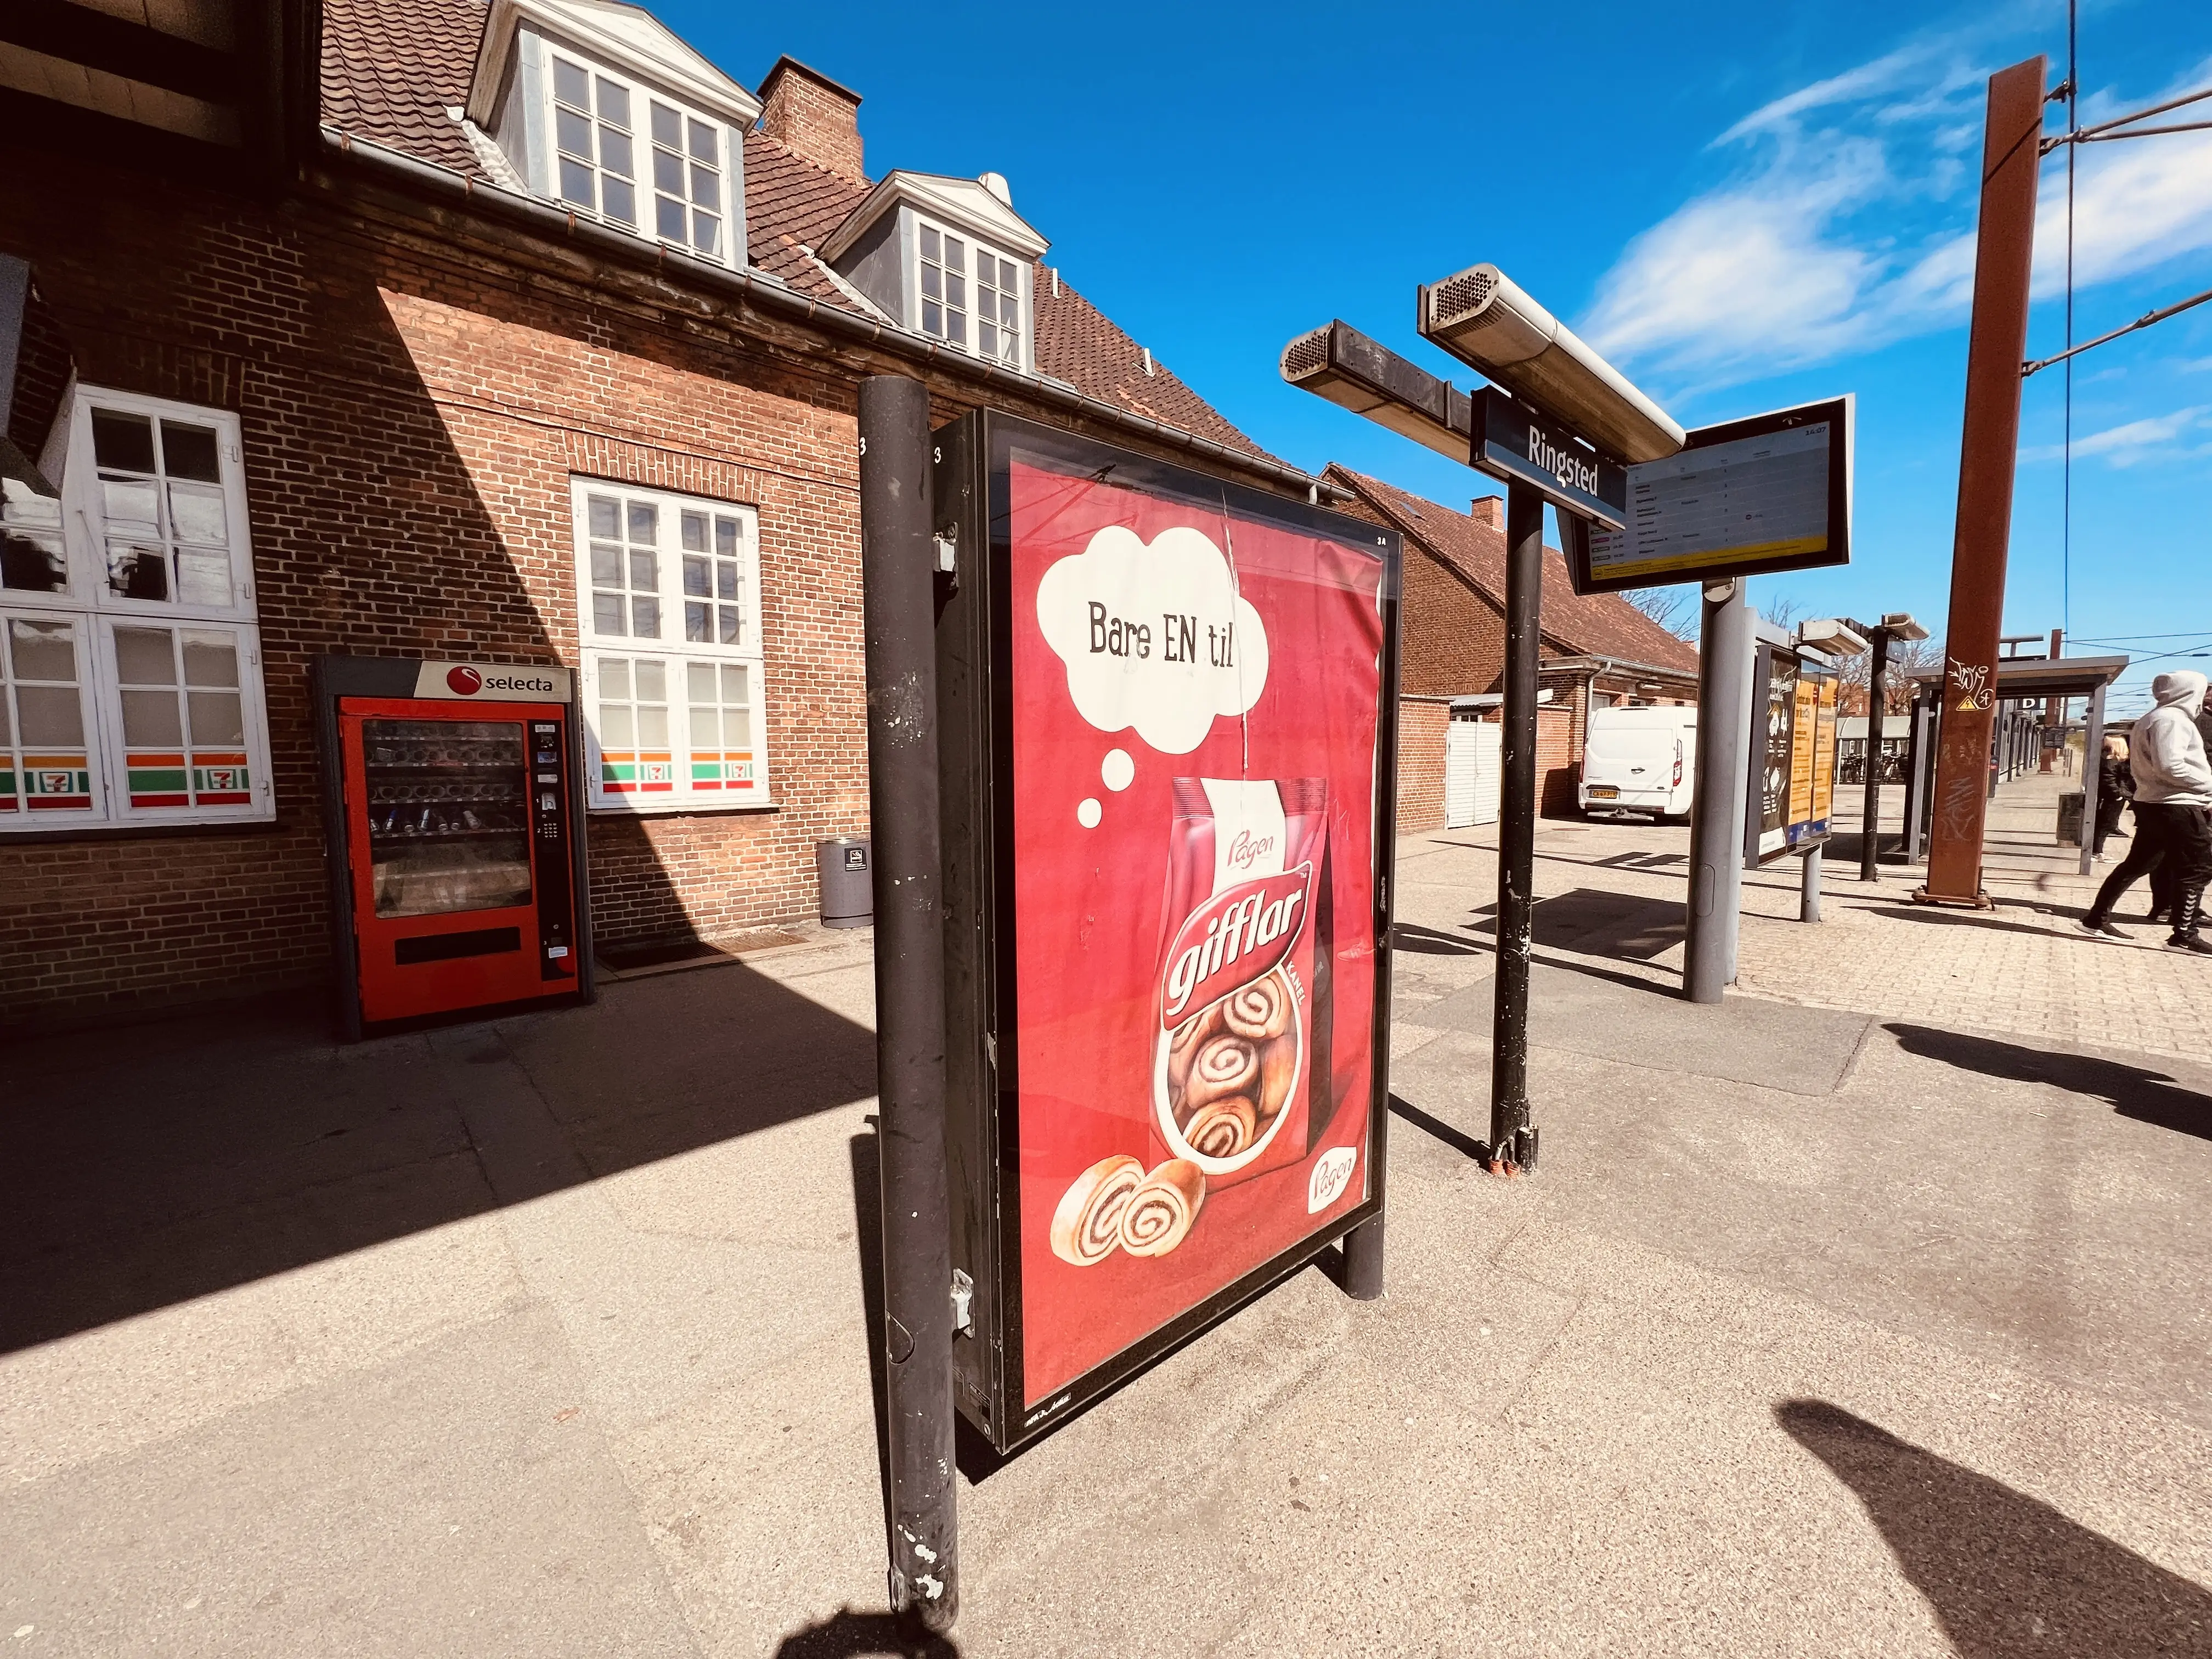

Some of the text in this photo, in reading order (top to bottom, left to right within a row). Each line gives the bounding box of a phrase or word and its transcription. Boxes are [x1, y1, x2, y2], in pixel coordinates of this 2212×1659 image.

[860, 437, 866, 455] 3
[934, 447, 941, 463] 3
[1528, 425, 1598, 496] Ringsted
[1377, 537, 1386, 546] 3A
[1088, 601, 1233, 667] Bare EN til
[485, 676, 552, 692] selecta
[2023, 698, 2036, 709] D
[1166, 889, 1302, 1017] gifflar
[1286, 961, 1306, 1006] KANEL
